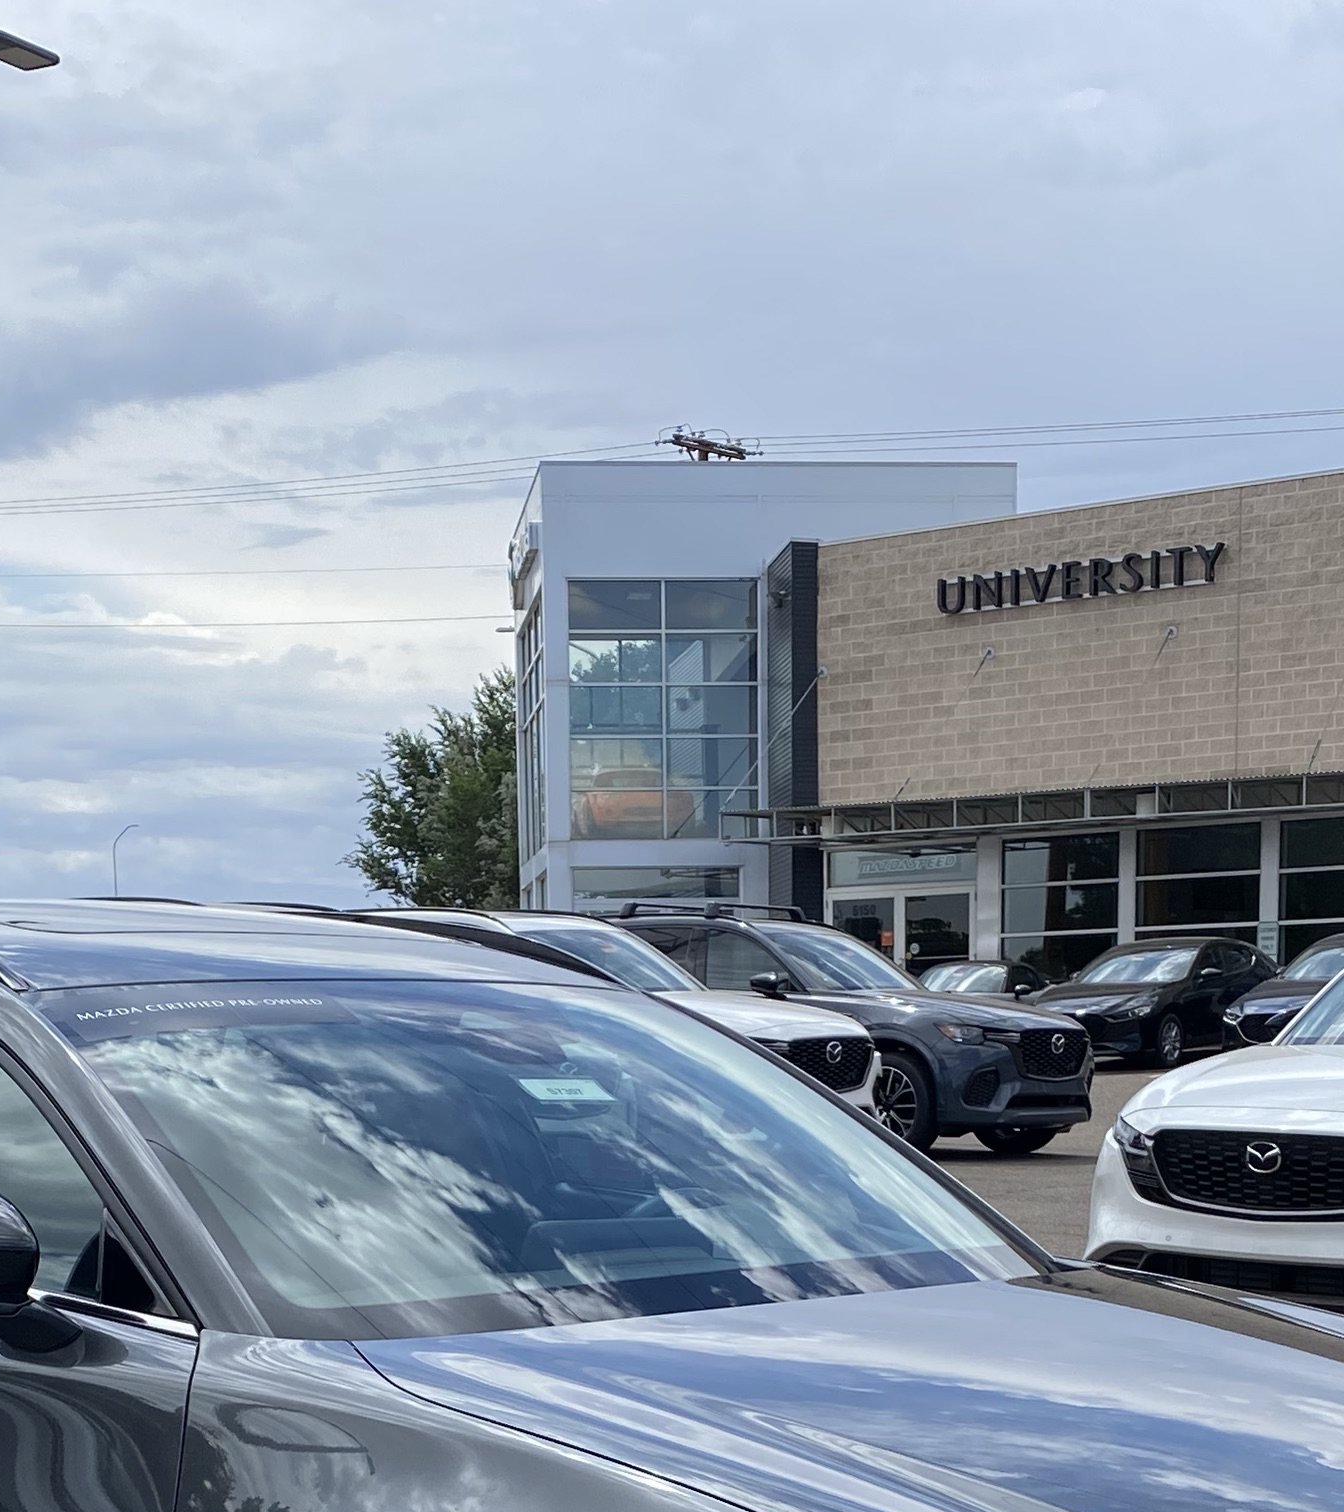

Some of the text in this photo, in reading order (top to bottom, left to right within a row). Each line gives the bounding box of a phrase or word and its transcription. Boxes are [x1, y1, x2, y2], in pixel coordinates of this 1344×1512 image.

[937, 542, 1225, 614] UNIVERSITY
[76, 998, 323, 1021] MAZDA CERTIFIED PRE-OWNED
